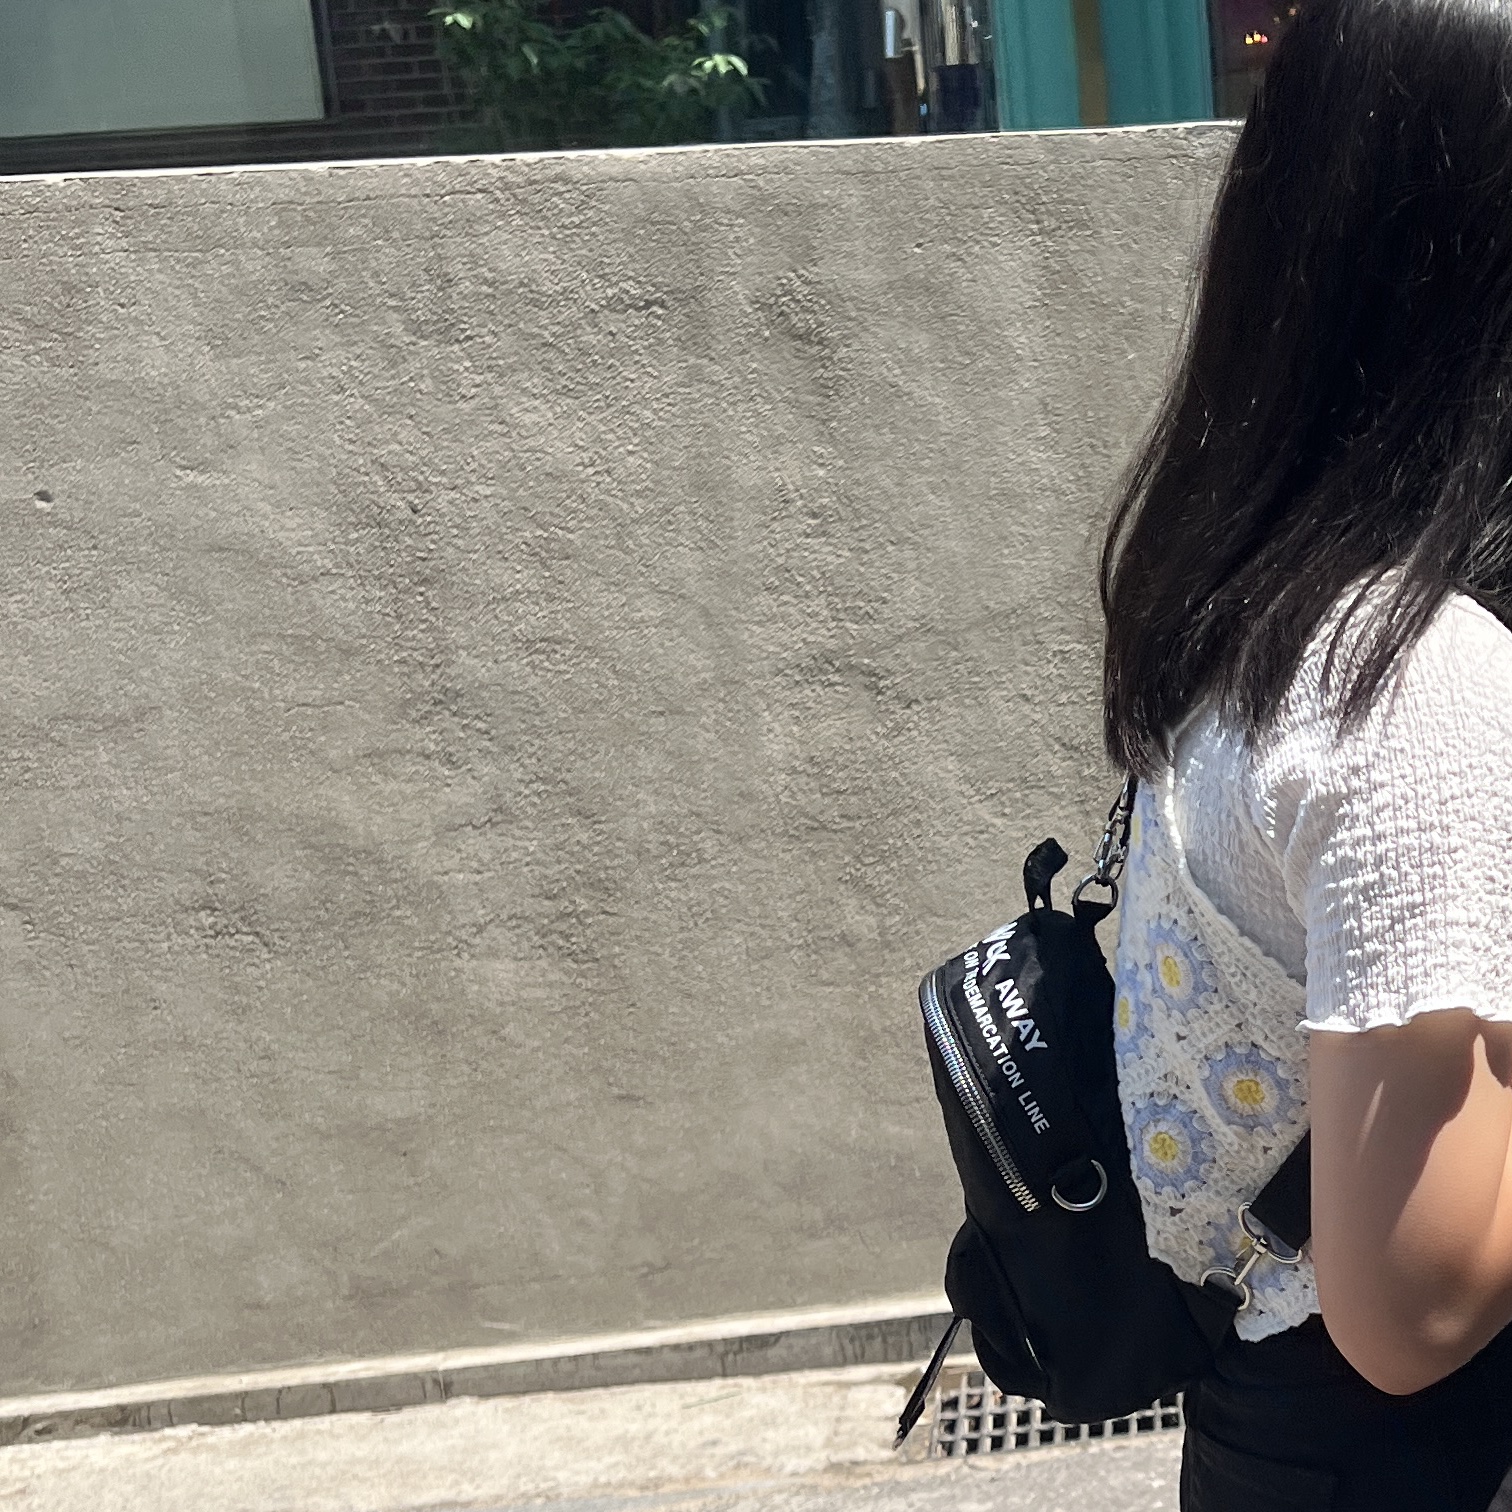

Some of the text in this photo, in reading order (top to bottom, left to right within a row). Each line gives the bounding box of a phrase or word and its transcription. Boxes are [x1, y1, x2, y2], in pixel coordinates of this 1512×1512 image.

[963, 978, 1025, 1089] DEMARCATION
[1017, 1090, 1051, 1135] LINE
[994, 978, 1049, 1052] AWAY
